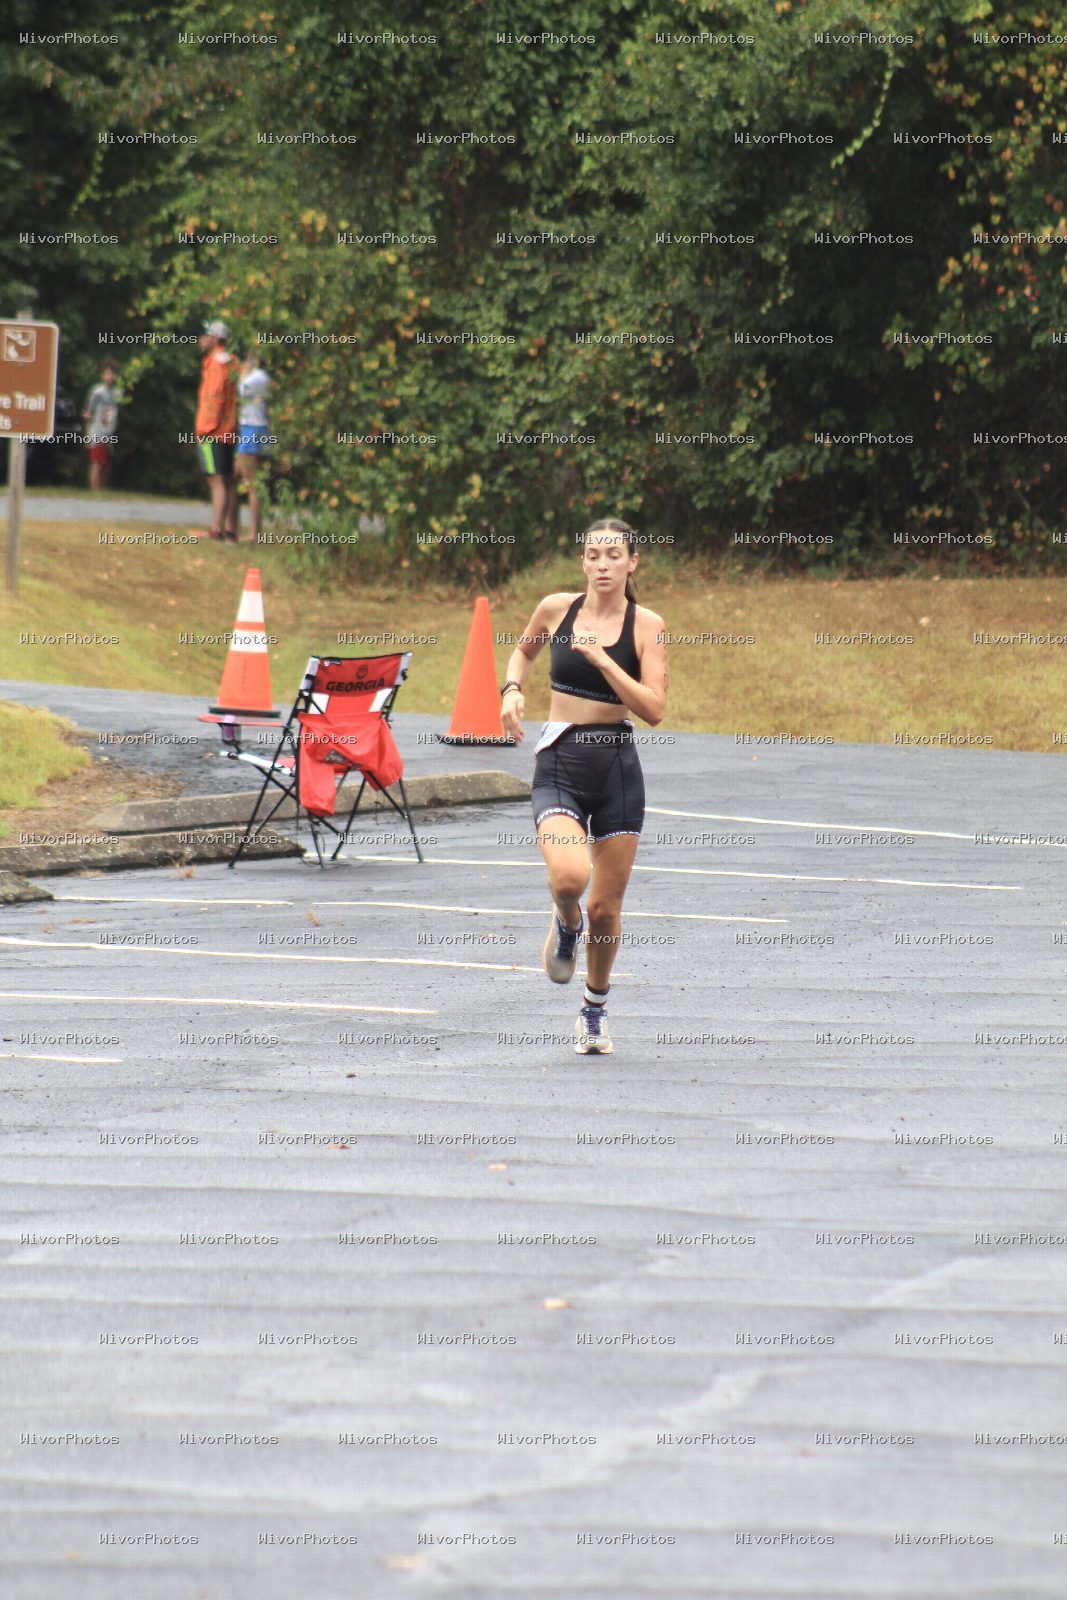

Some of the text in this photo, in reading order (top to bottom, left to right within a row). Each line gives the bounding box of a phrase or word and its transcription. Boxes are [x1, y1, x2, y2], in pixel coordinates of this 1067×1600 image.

[15, 394, 46, 411] Trail
[326, 678, 385, 692] GEORGIA
[573, 688, 608, 700] ARMOUR
